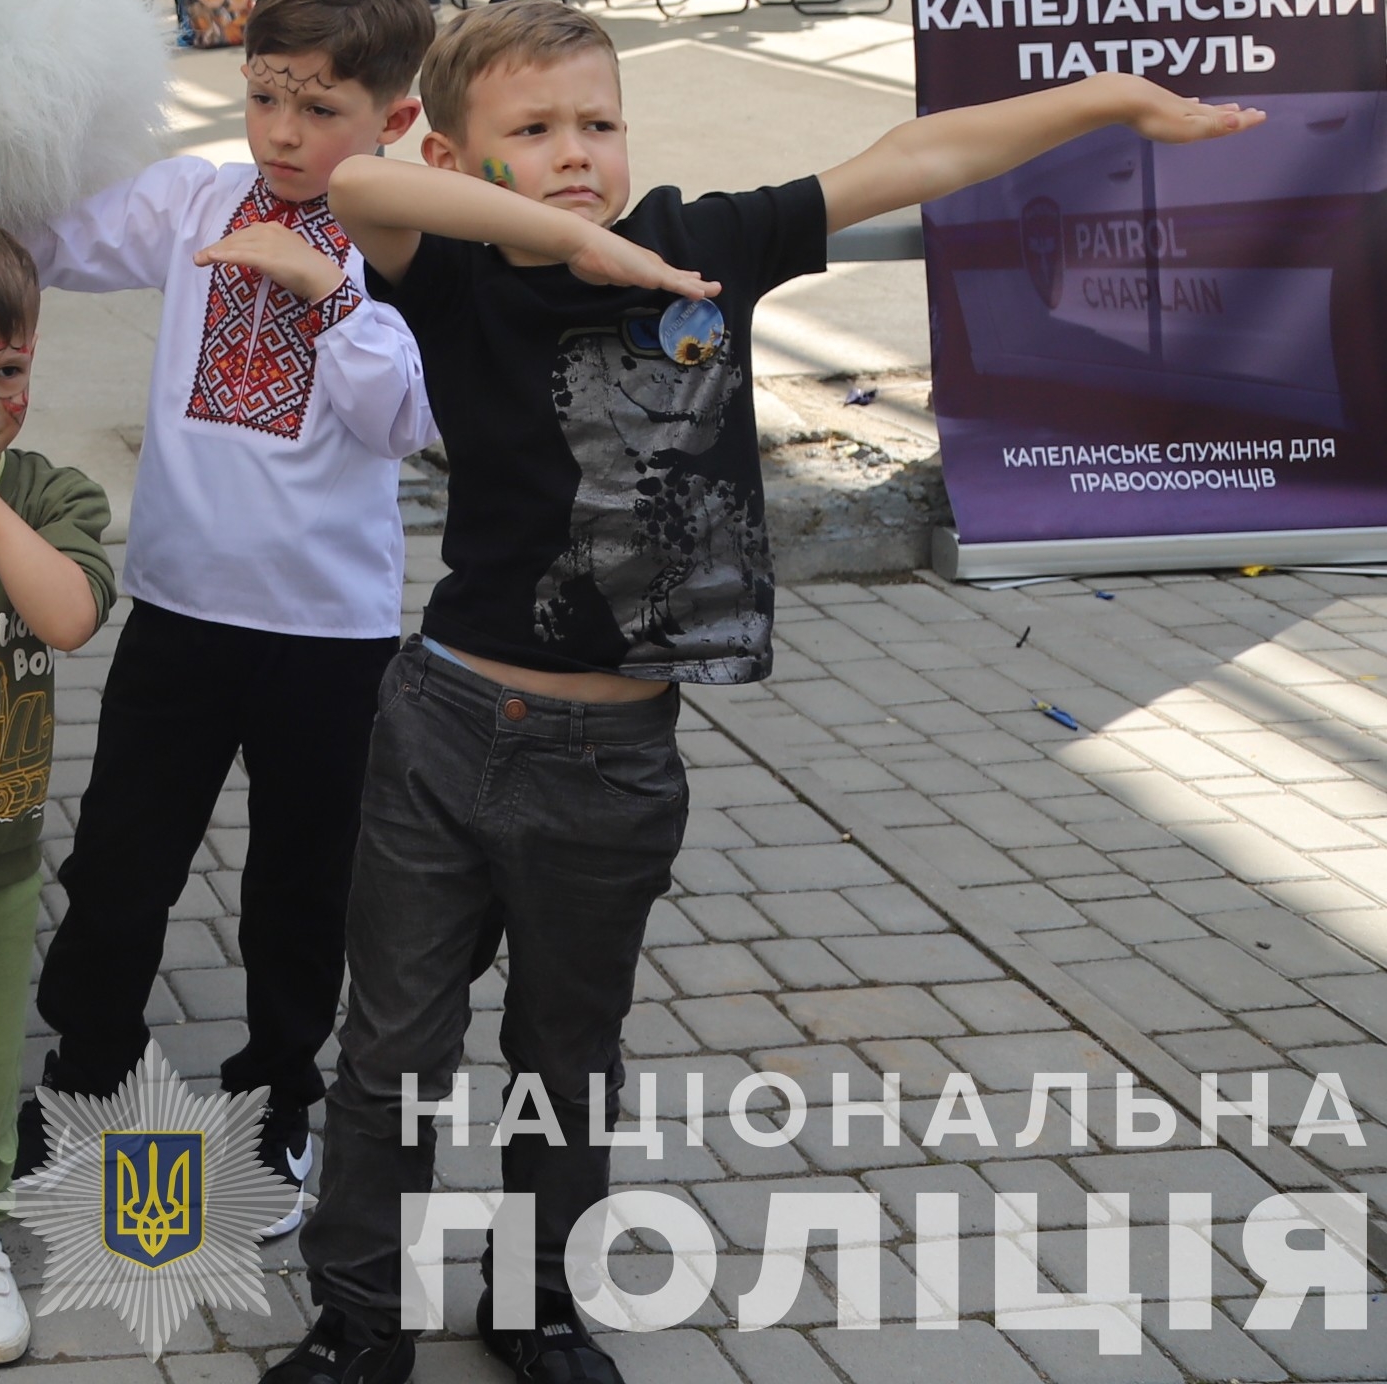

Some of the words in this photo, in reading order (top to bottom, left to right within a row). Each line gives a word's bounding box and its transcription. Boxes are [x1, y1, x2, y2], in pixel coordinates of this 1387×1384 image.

[1018, 35, 1277, 81] ПАТРУЛЬ
[1077, 217, 1188, 260] PATROL
[1082, 277, 1225, 313] CHAPLAIN
[1002, 444, 1162, 468] КАПЕЛАНСЬКЕ
[1166, 440, 1283, 463] СЛУЖІННЯ
[1288, 438, 1336, 462] ДЛЯ
[1070, 467, 1276, 493] ПРАВООХОРОНЦІВ
[541, 1323, 573, 1337] NIKE
